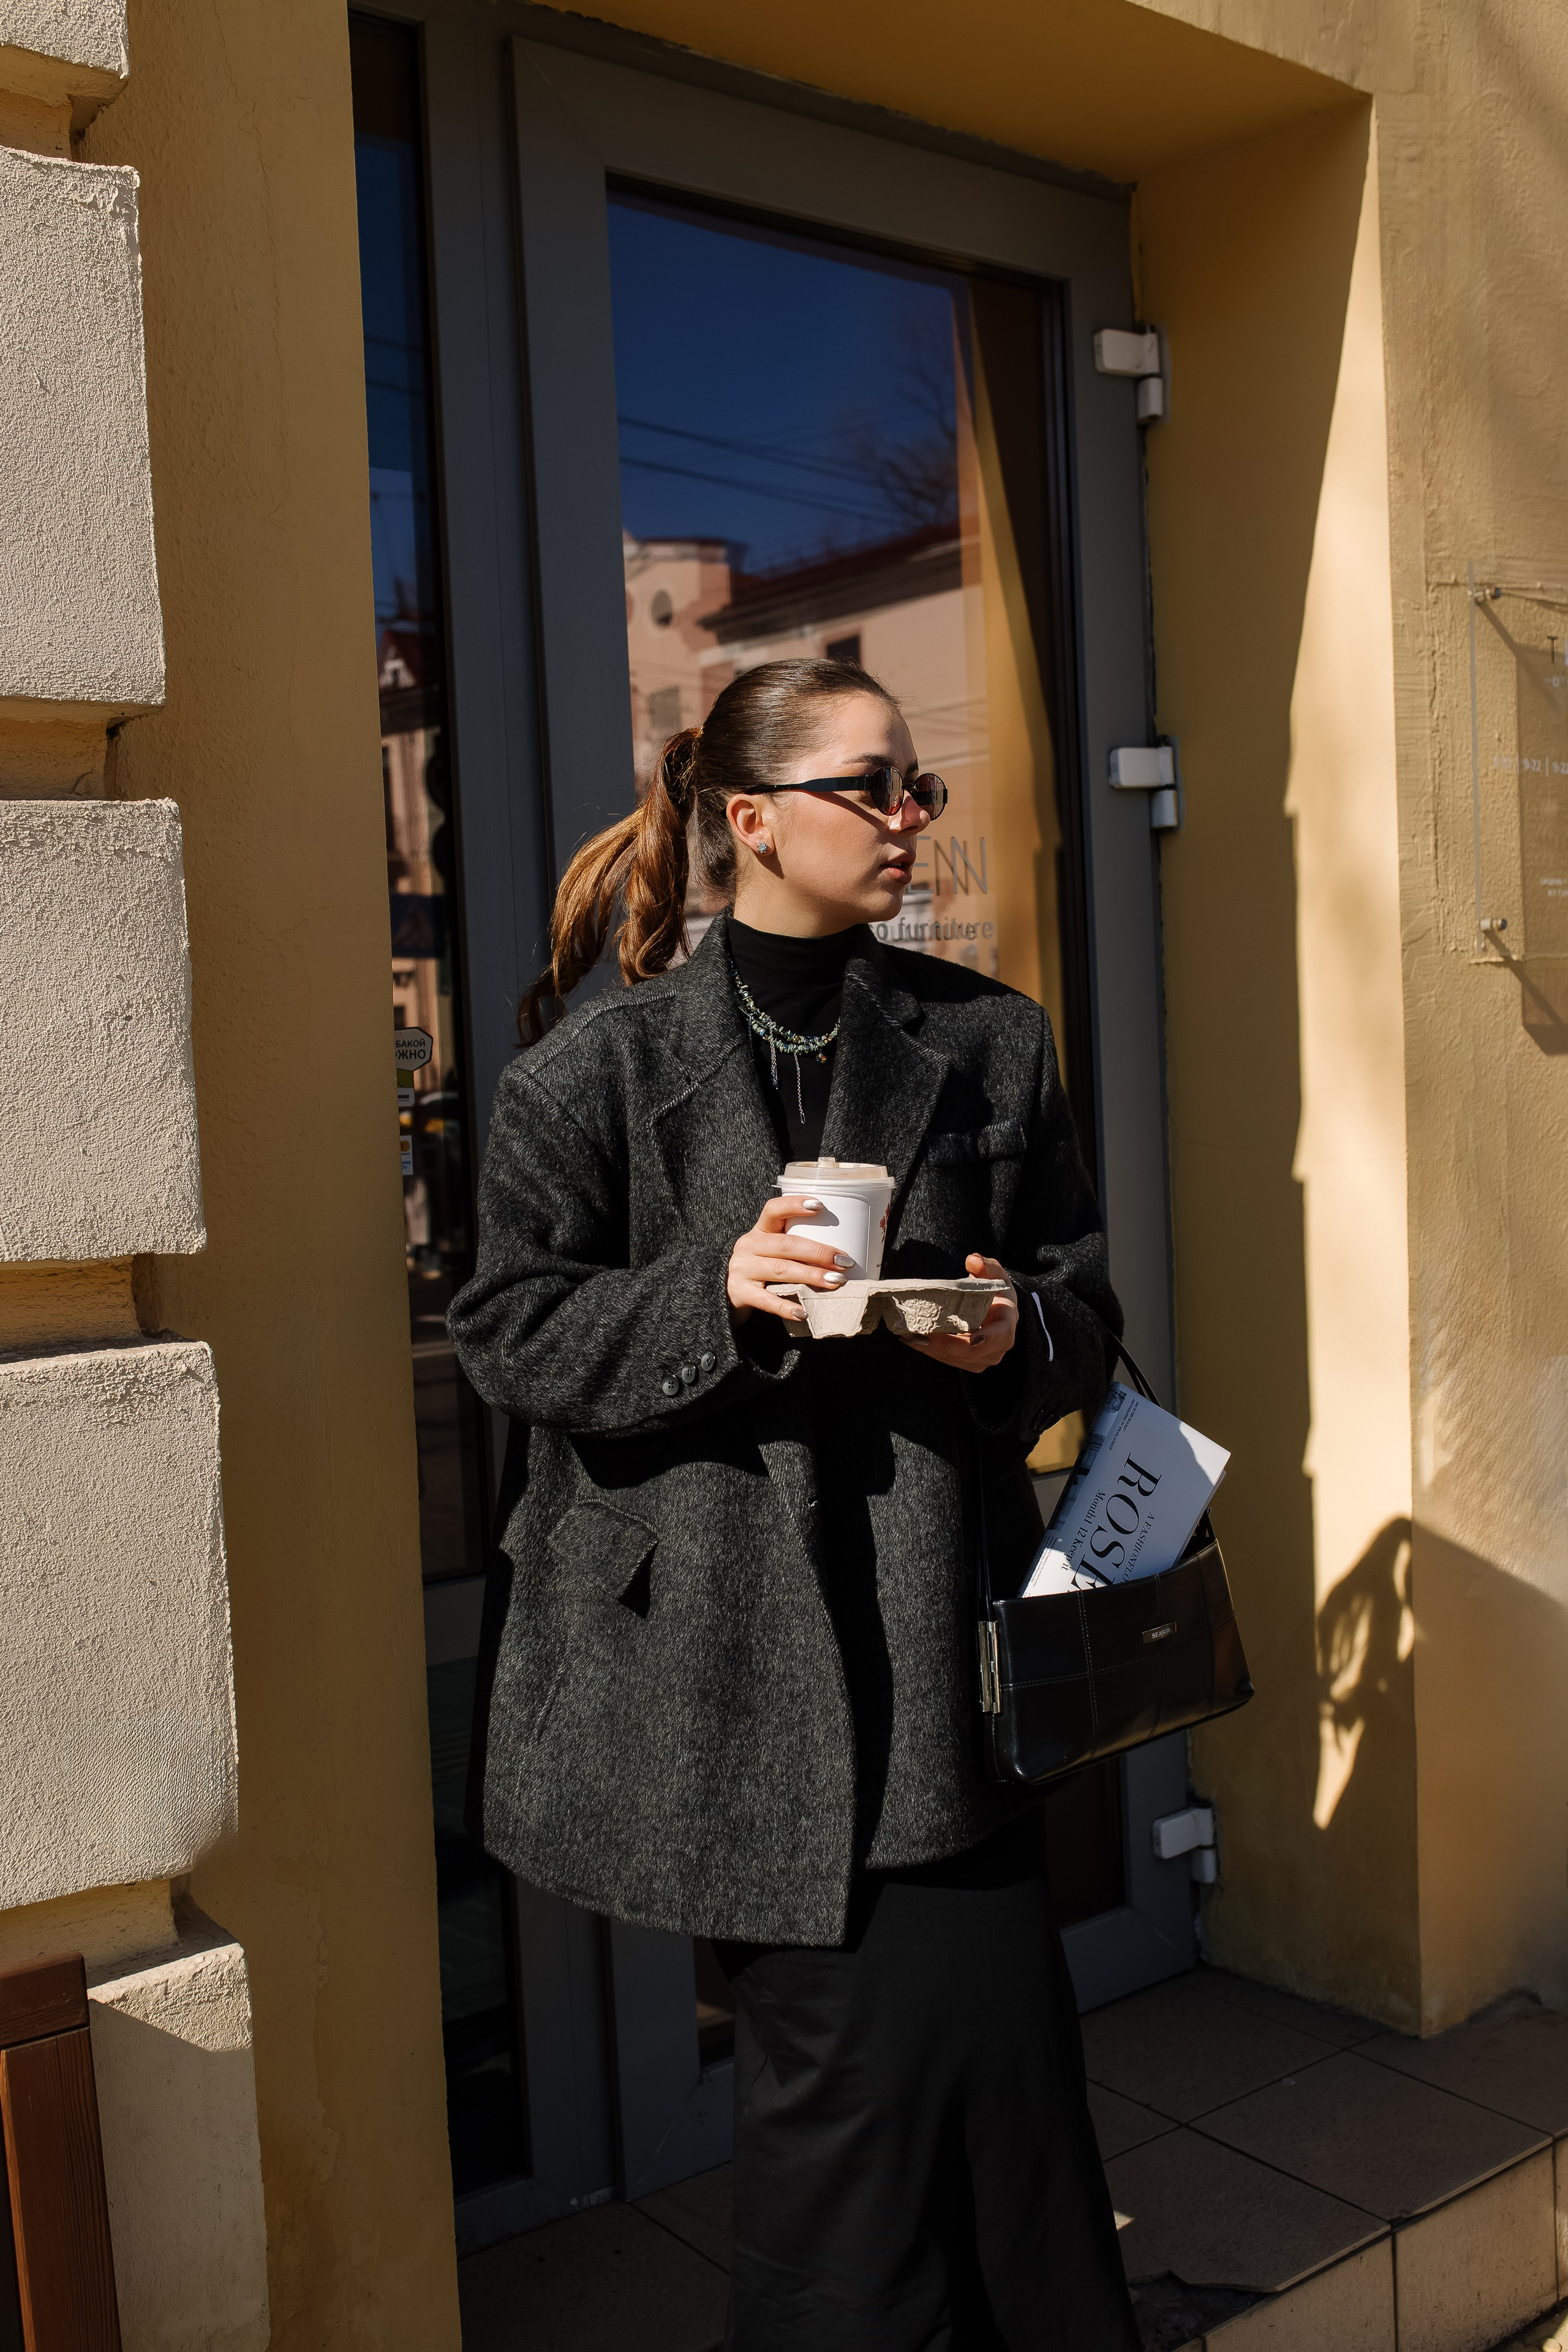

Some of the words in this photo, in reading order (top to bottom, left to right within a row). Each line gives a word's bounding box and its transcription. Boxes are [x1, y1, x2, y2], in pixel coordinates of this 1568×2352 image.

[1067, 1452, 1163, 1593] ROSE
[1148, 1511, 1156, 1521] A
[1063, 1536, 1085, 1562] Keep
[1119, 1520, 1153, 1583] FASHIONFLO
[1060, 1560, 1072, 1572] it
[1152, 1627, 1170, 1638] SEASON
